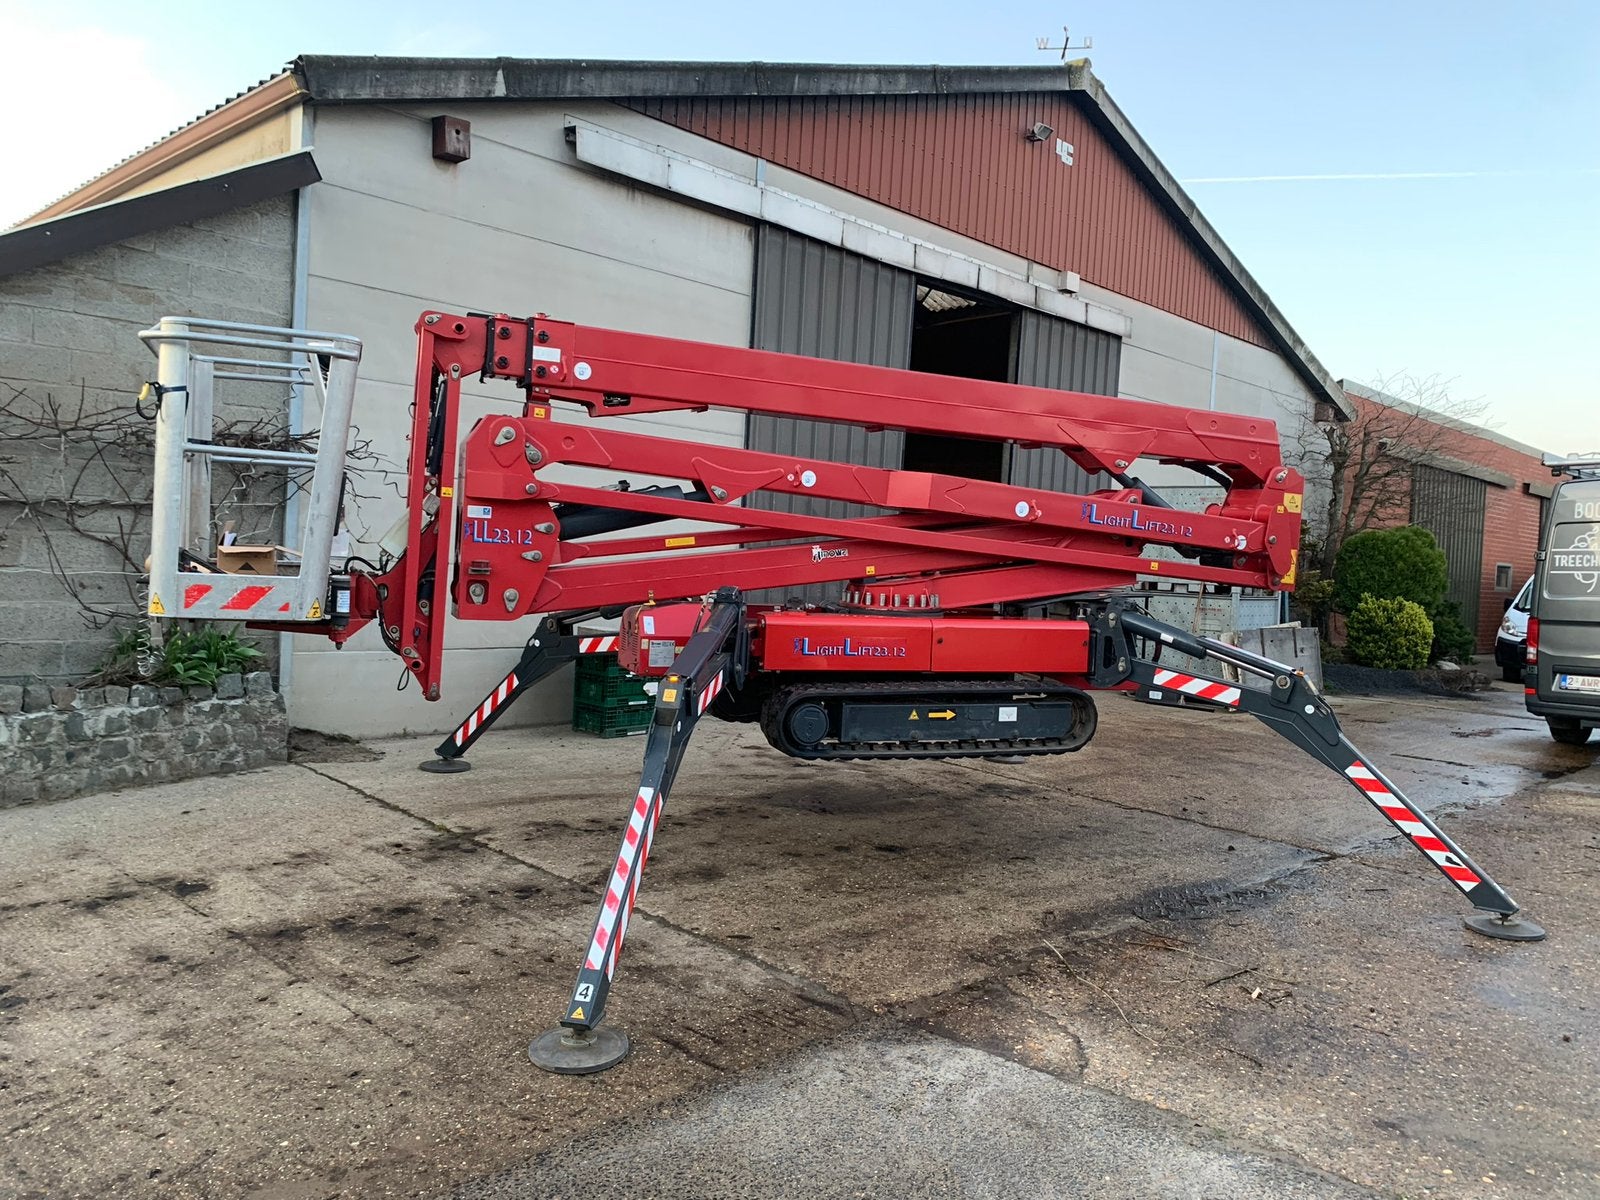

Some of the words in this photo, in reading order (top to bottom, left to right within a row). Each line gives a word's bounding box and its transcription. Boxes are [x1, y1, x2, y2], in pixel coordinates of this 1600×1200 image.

[473, 520, 533, 545] LL23.12
[1553, 554, 1600, 567] TREECH
[578, 985, 590, 1000] 4
